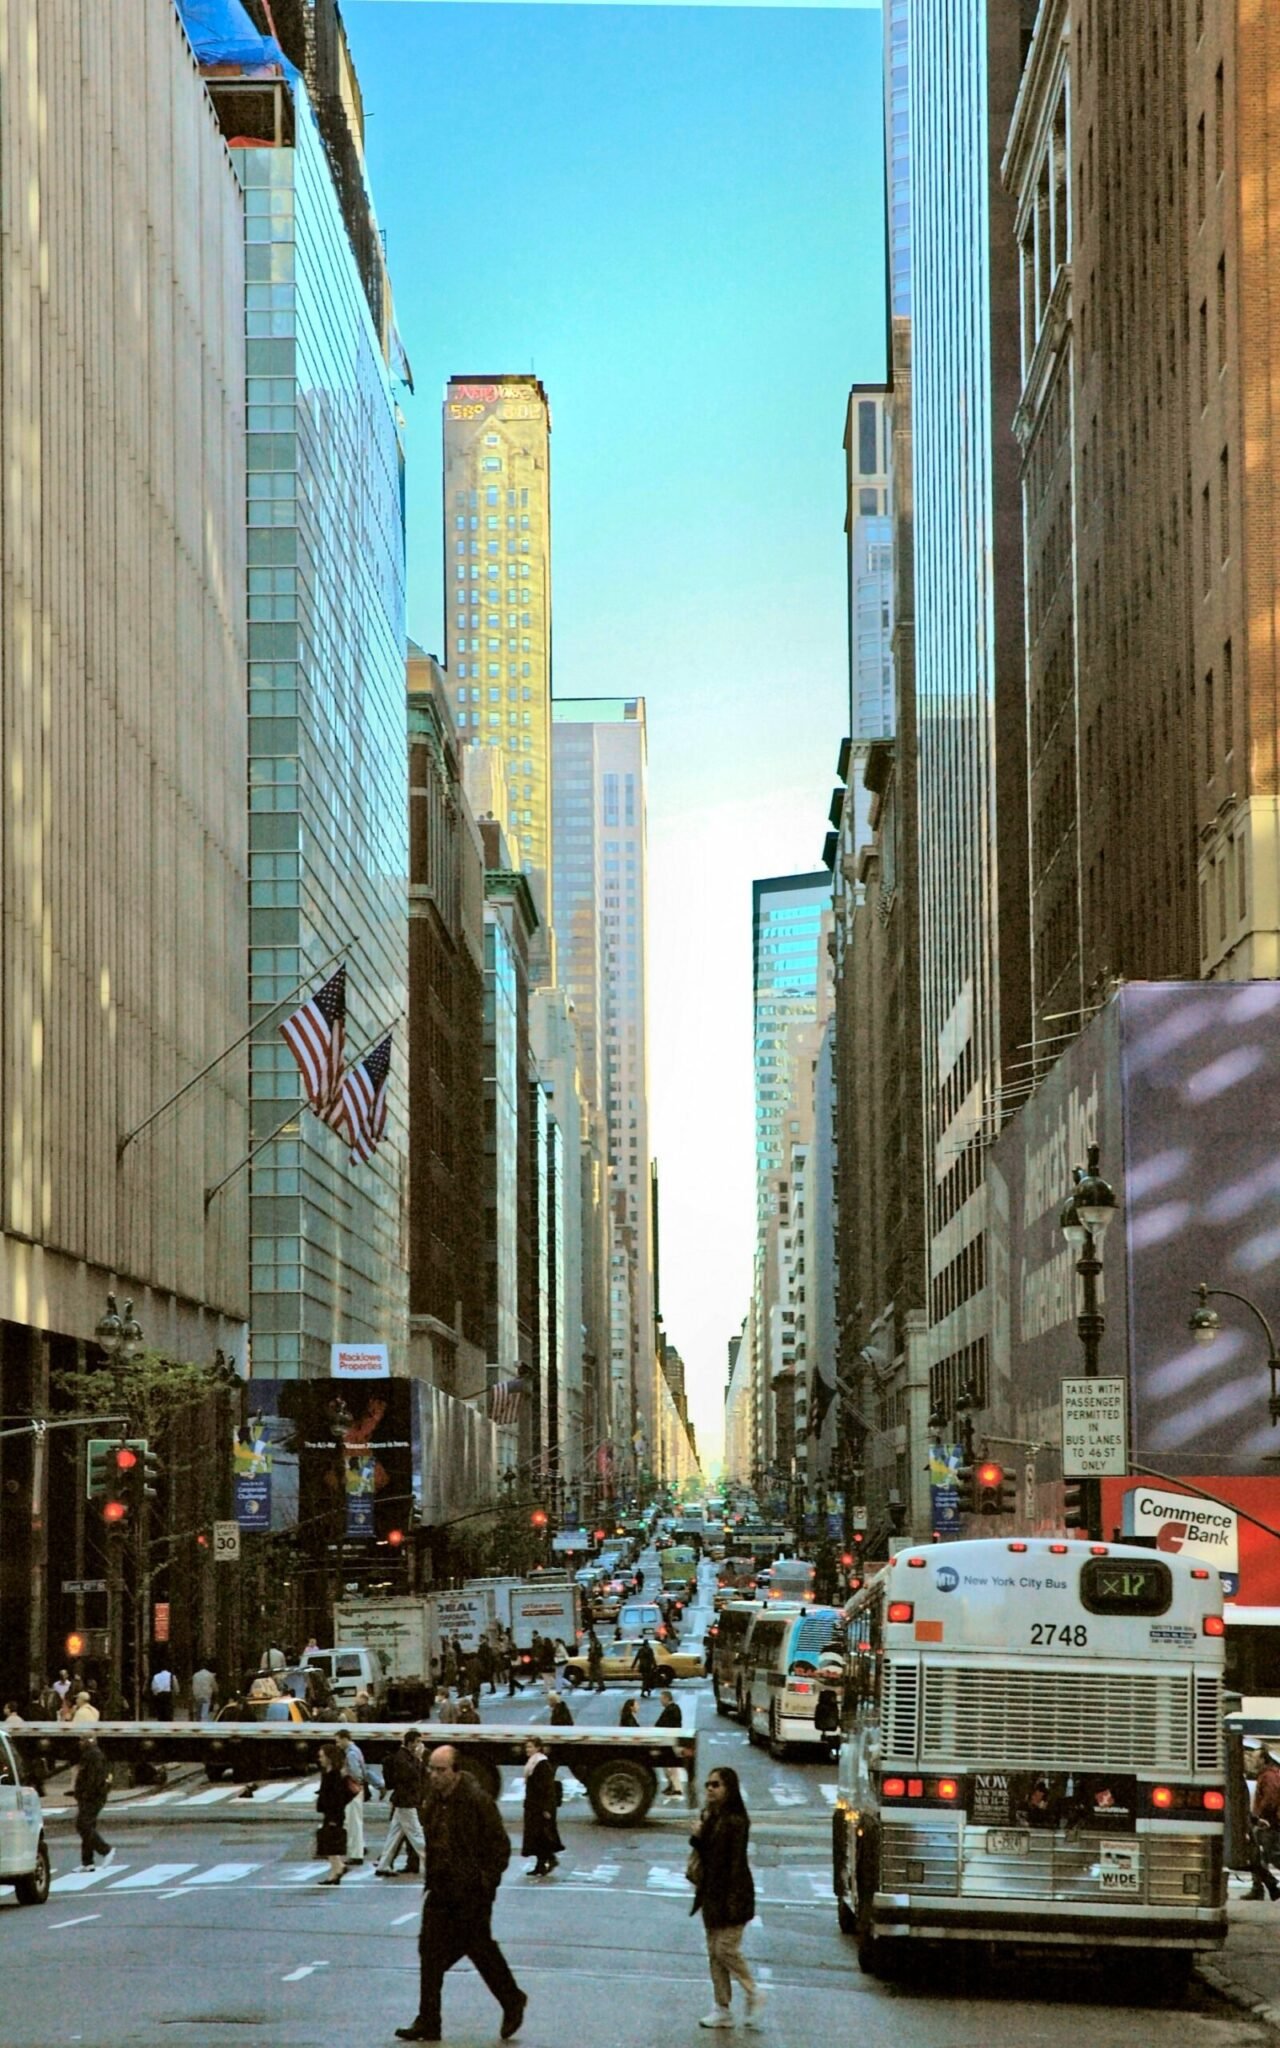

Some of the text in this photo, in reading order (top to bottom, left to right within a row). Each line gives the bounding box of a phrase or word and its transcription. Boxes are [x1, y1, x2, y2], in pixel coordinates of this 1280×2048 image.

[339, 1352, 382, 1361] Macklowe
[339, 1361, 382, 1372] Properties
[1066, 1385, 1120, 1394] TAXIS WITH
[1066, 1397, 1120, 1407] PASSENGER
[1067, 1410, 1120, 1420] PERMITTED
[1088, 1423, 1099, 1432] IN
[1066, 1435, 1122, 1445] BUS LANES
[1072, 1447, 1115, 1457] TO 46 ST
[1081, 1461, 1106, 1470] ONLY
[1140, 1498, 1232, 1528] Commerce
[1187, 1525, 1229, 1546] Bank
[217, 1537, 236, 1550] 30
[963, 1576, 1067, 1590] New York City Bus
[1031, 1623, 1087, 1647] 2748
[976, 1775, 1009, 1788] NOW
[1103, 1873, 1137, 1884] WIDE
